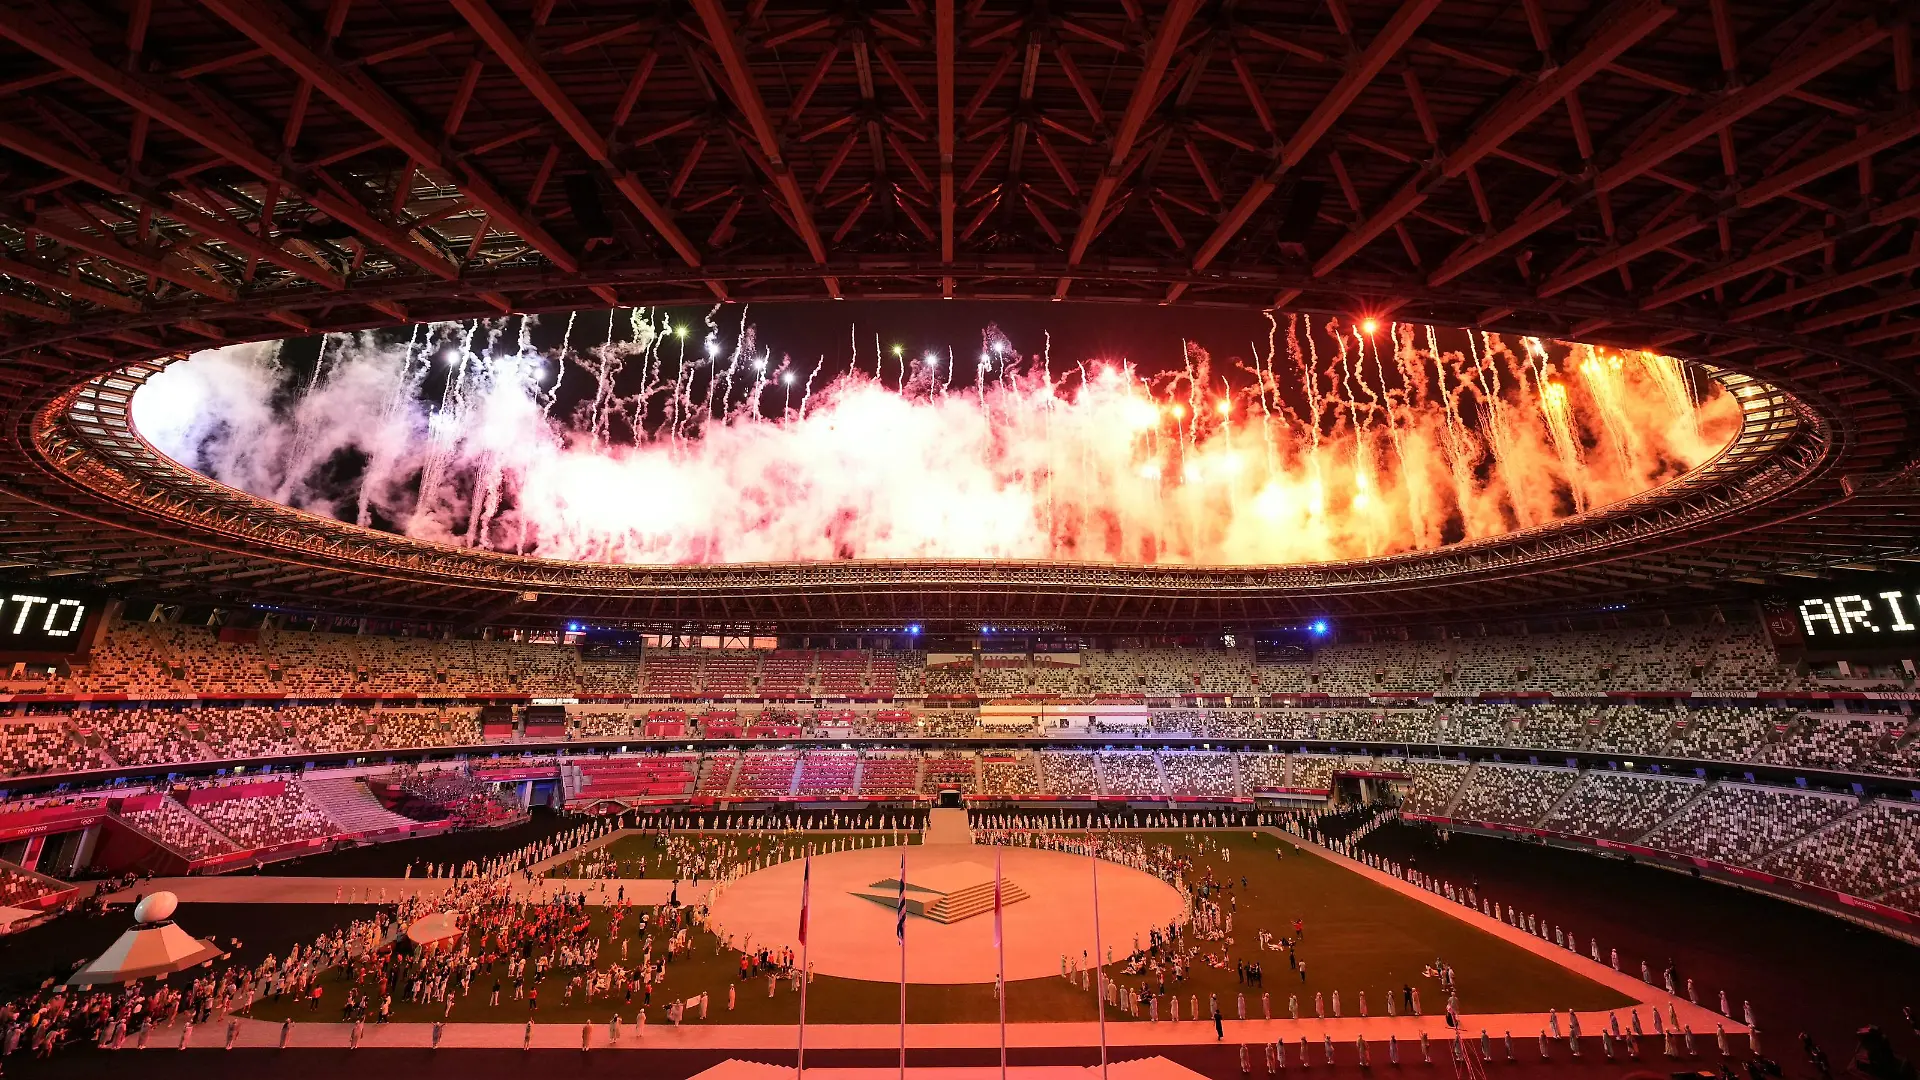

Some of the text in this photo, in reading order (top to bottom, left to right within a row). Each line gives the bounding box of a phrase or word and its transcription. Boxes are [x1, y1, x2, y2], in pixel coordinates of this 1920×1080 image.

[0, 595, 85, 637] TO
[1799, 591, 1920, 636] ARI
[1877, 692, 1909, 700] TOKYO
[17, 827, 34, 835] TOKYO
